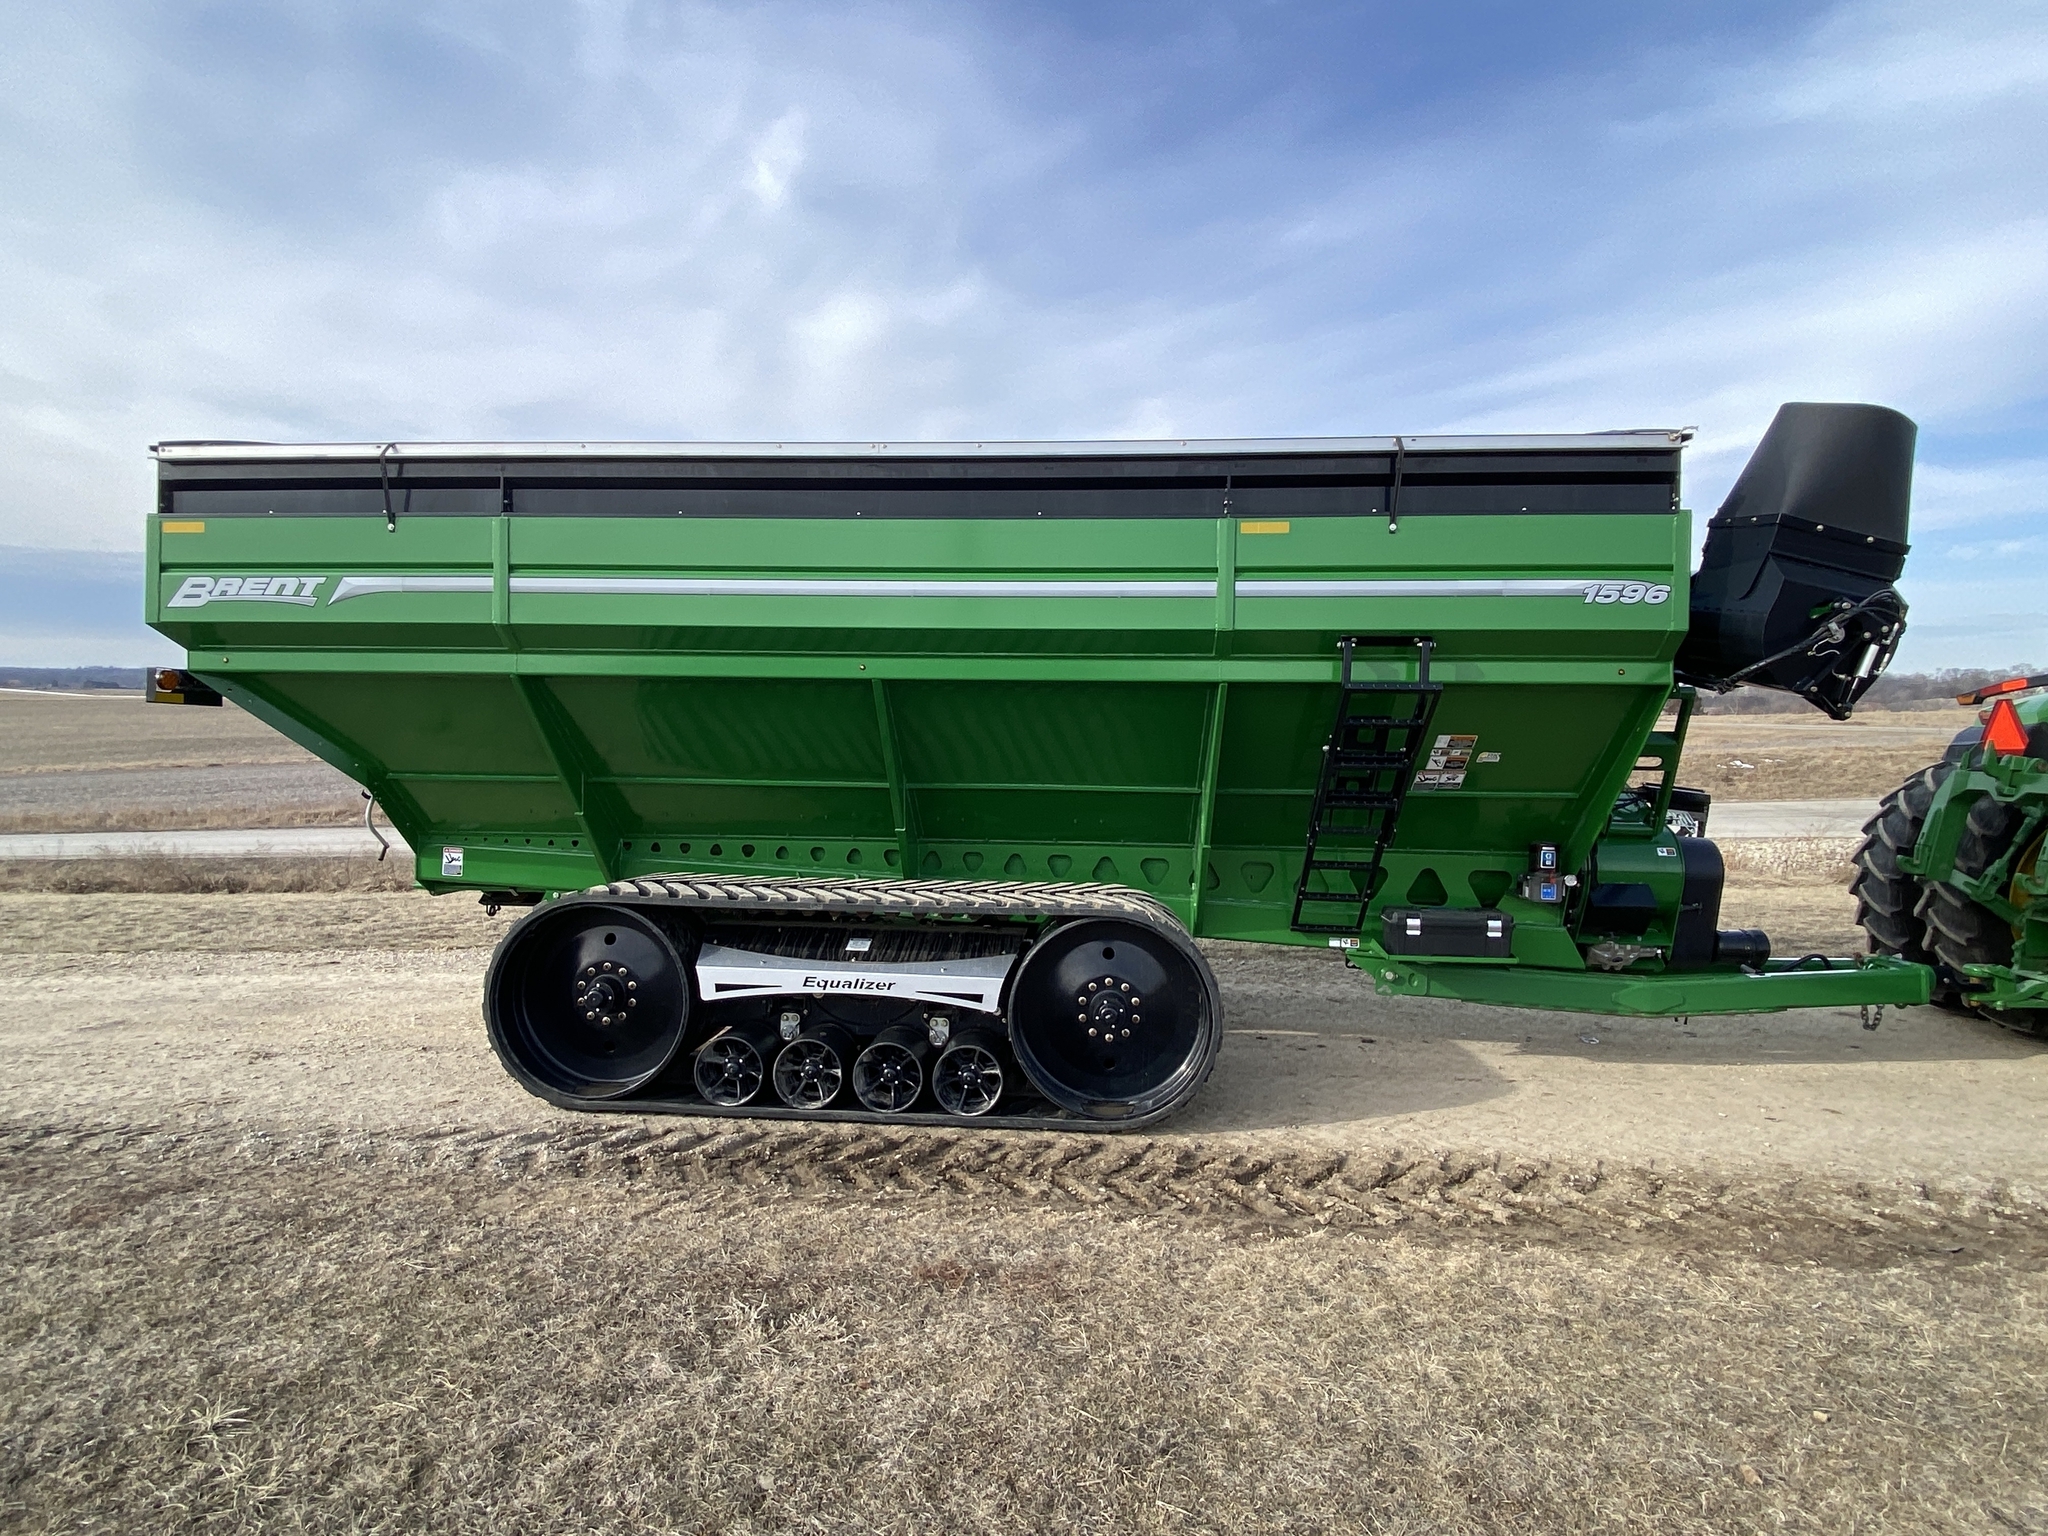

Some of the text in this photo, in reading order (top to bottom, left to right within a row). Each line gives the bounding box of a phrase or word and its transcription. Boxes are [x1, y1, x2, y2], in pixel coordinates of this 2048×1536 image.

[166, 576, 328, 607] BRENT
[1583, 584, 1671, 605] 1596
[802, 976, 897, 991] Equalizer
